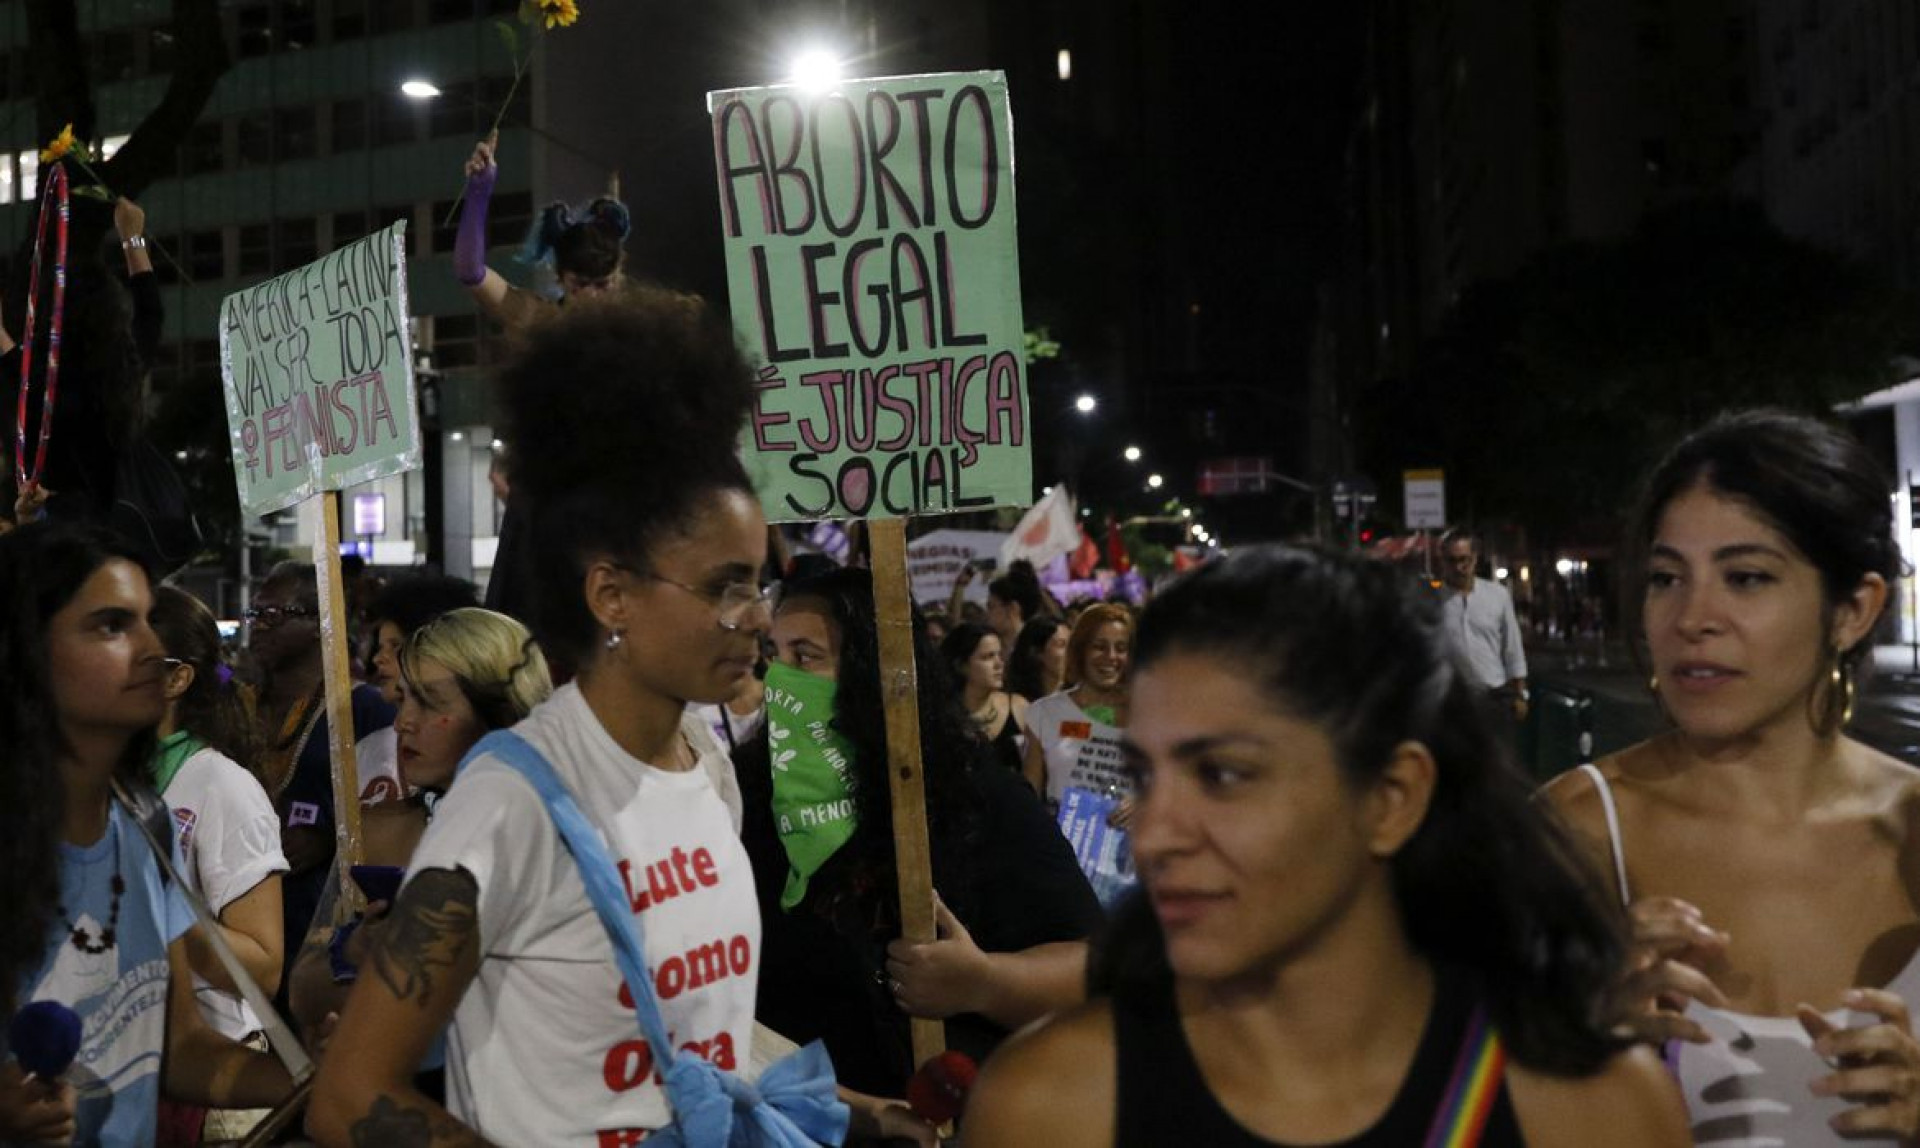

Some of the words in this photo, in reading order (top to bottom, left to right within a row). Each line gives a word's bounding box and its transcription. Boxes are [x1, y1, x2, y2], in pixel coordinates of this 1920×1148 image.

[717, 84, 998, 237] ABORTO
[751, 232, 988, 362] LEGAL
[232, 350, 275, 417] VAI
[276, 325, 323, 403] SER
[326, 299, 405, 380] TODA
[262, 370, 398, 479] FENISTA
[751, 364, 797, 452] É
[797, 350, 1024, 468] JUSTIÇA
[785, 448, 995, 516] SOCIAL
[764, 686, 804, 716] ORTA
[780, 814, 793, 834] A
[616, 846, 719, 914] Lute
[603, 1030, 736, 1093] Oa
